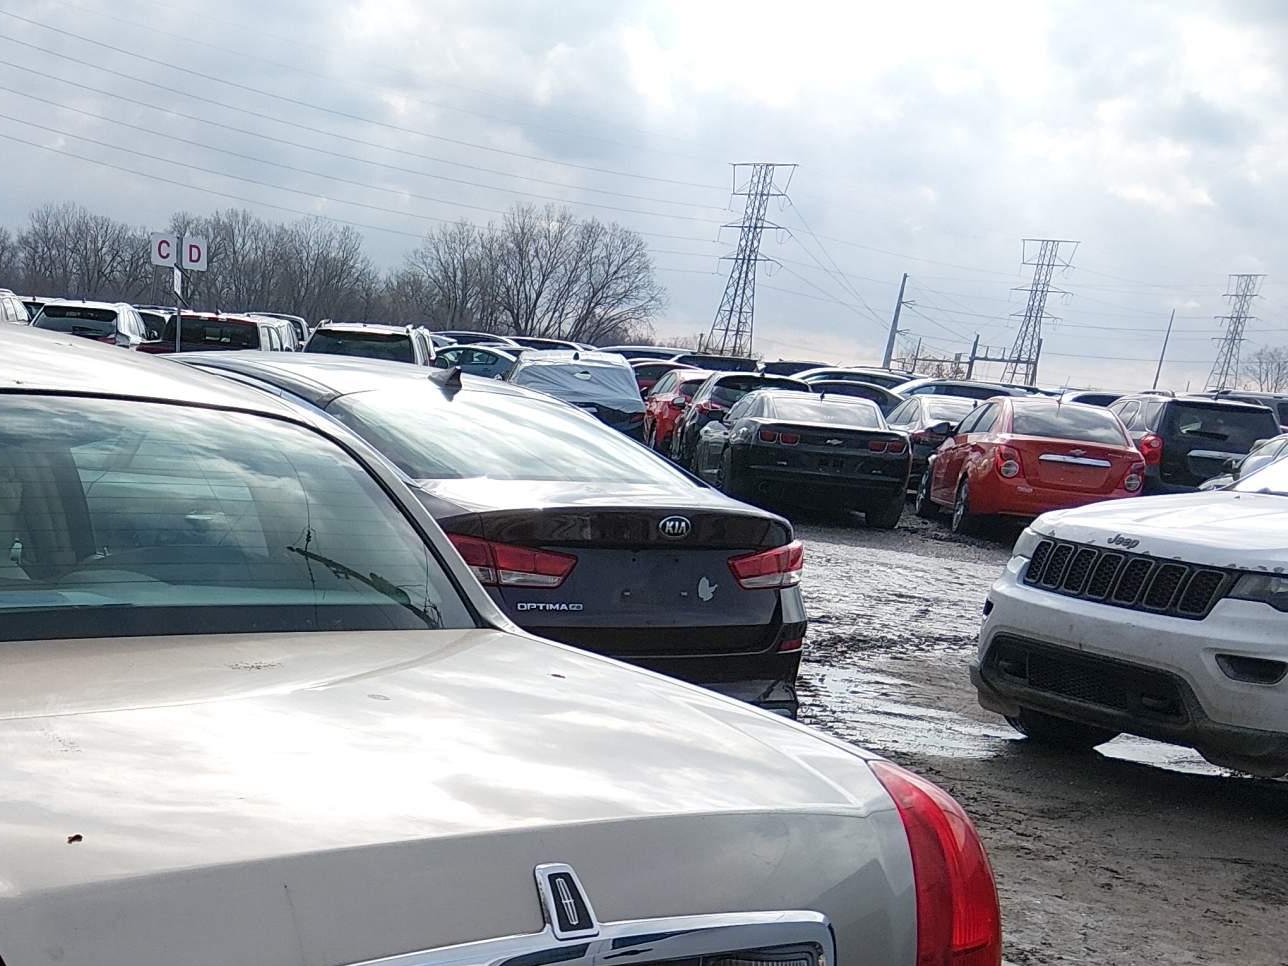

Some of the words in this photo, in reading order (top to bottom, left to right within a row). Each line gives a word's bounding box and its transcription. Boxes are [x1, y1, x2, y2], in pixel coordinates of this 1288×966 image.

[158, 240, 170, 259] C
[189, 244, 201, 263] D
[665, 521, 686, 534] KIA
[1107, 533, 1140, 549] Jeep
[517, 603, 568, 611] OPTIMA
